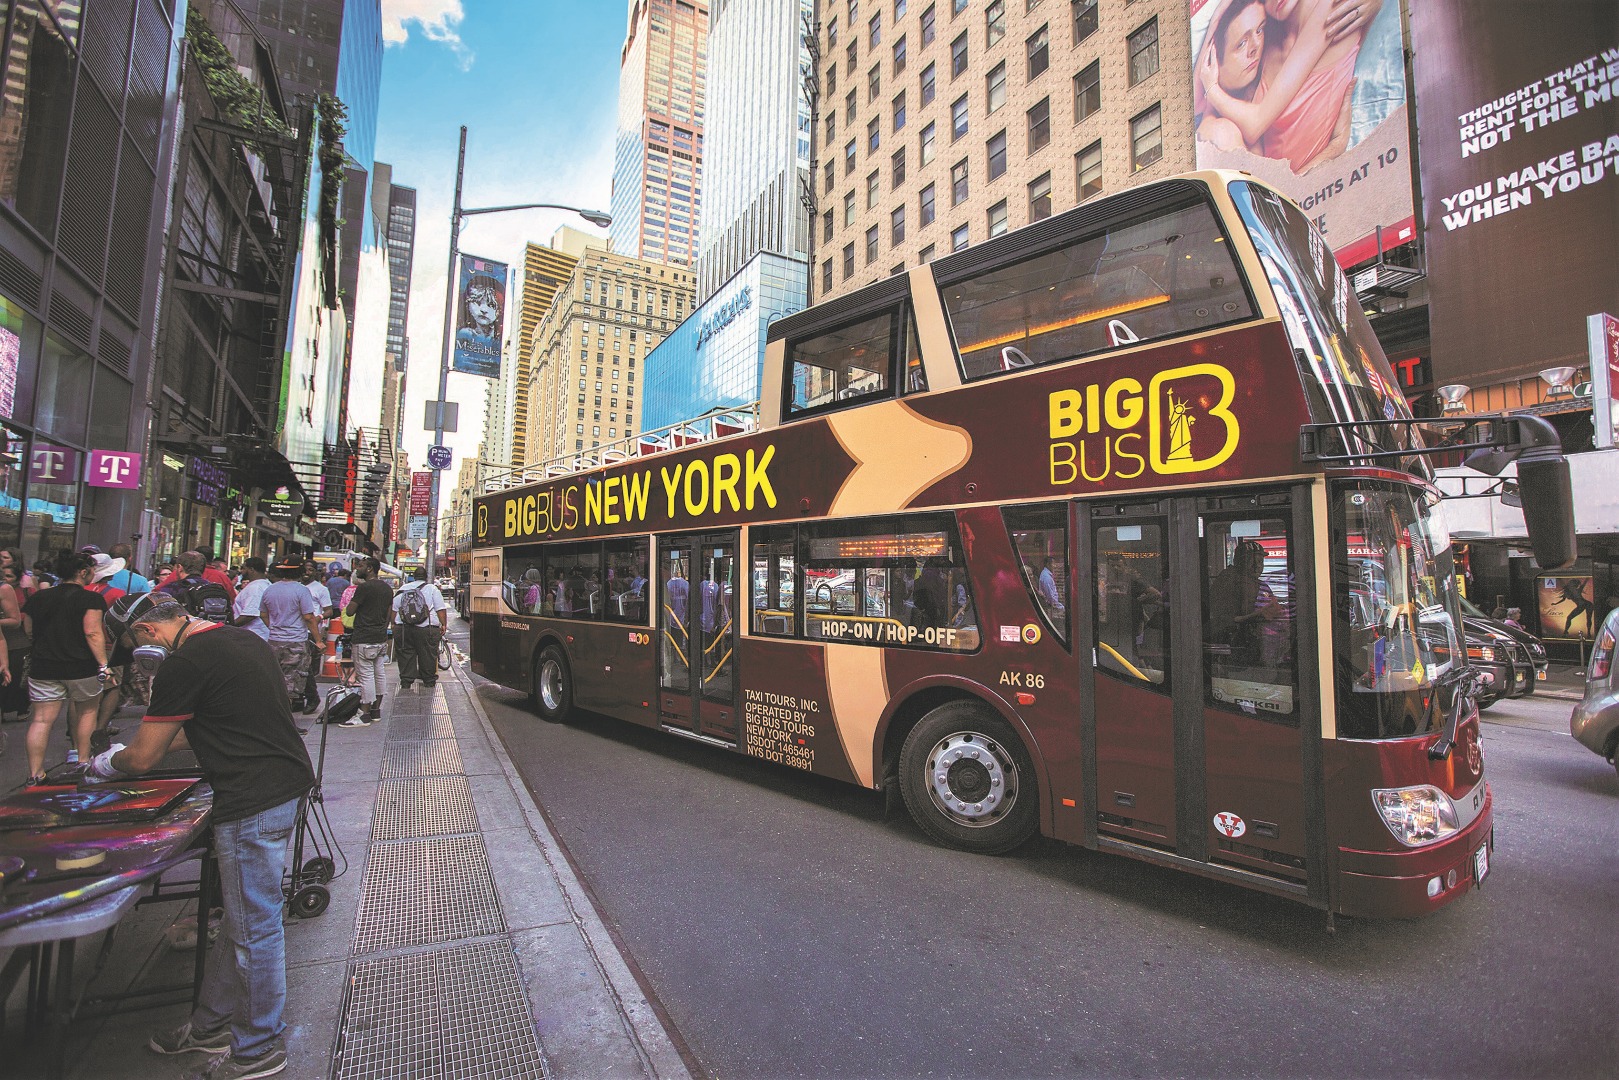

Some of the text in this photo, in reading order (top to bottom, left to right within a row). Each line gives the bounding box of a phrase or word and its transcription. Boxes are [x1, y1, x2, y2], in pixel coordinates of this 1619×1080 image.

[1458, 80, 1542, 126] THOUGHT
[1544, 56, 1597, 88] THAT
[1460, 105, 1517, 141] RENT
[1520, 85, 1567, 116] FOR
[1461, 122, 1515, 159] NOT
[1519, 96, 1579, 133] THE
[1349, 162, 1370, 186] AT
[1378, 147, 1398, 169] 10
[1441, 181, 1492, 212] YOU
[1497, 150, 1577, 193] MAKE
[1442, 187, 1532, 231] WHEN
[1049, 377, 1144, 439] BIG
[100, 455, 130, 484] T
[1049, 433, 1146, 486] BUS
[585, 470, 651, 527] NEW
[660, 444, 777, 518] YORK
[821, 621, 873, 639] HOP-ON
[886, 624, 957, 646] HOP-OFF
[999, 670, 1045, 689] AK 86
[745, 689, 820, 713] TAXI TOURS, INC.
[745, 702, 807, 723] OPERATED BY
[745, 712, 815, 737] BIG BUS TOURS
[746, 723, 793, 743] NEW YORK
[746, 734, 815, 760] USDOT 1465461
[747, 744, 812, 771] NYS DOT 38991
